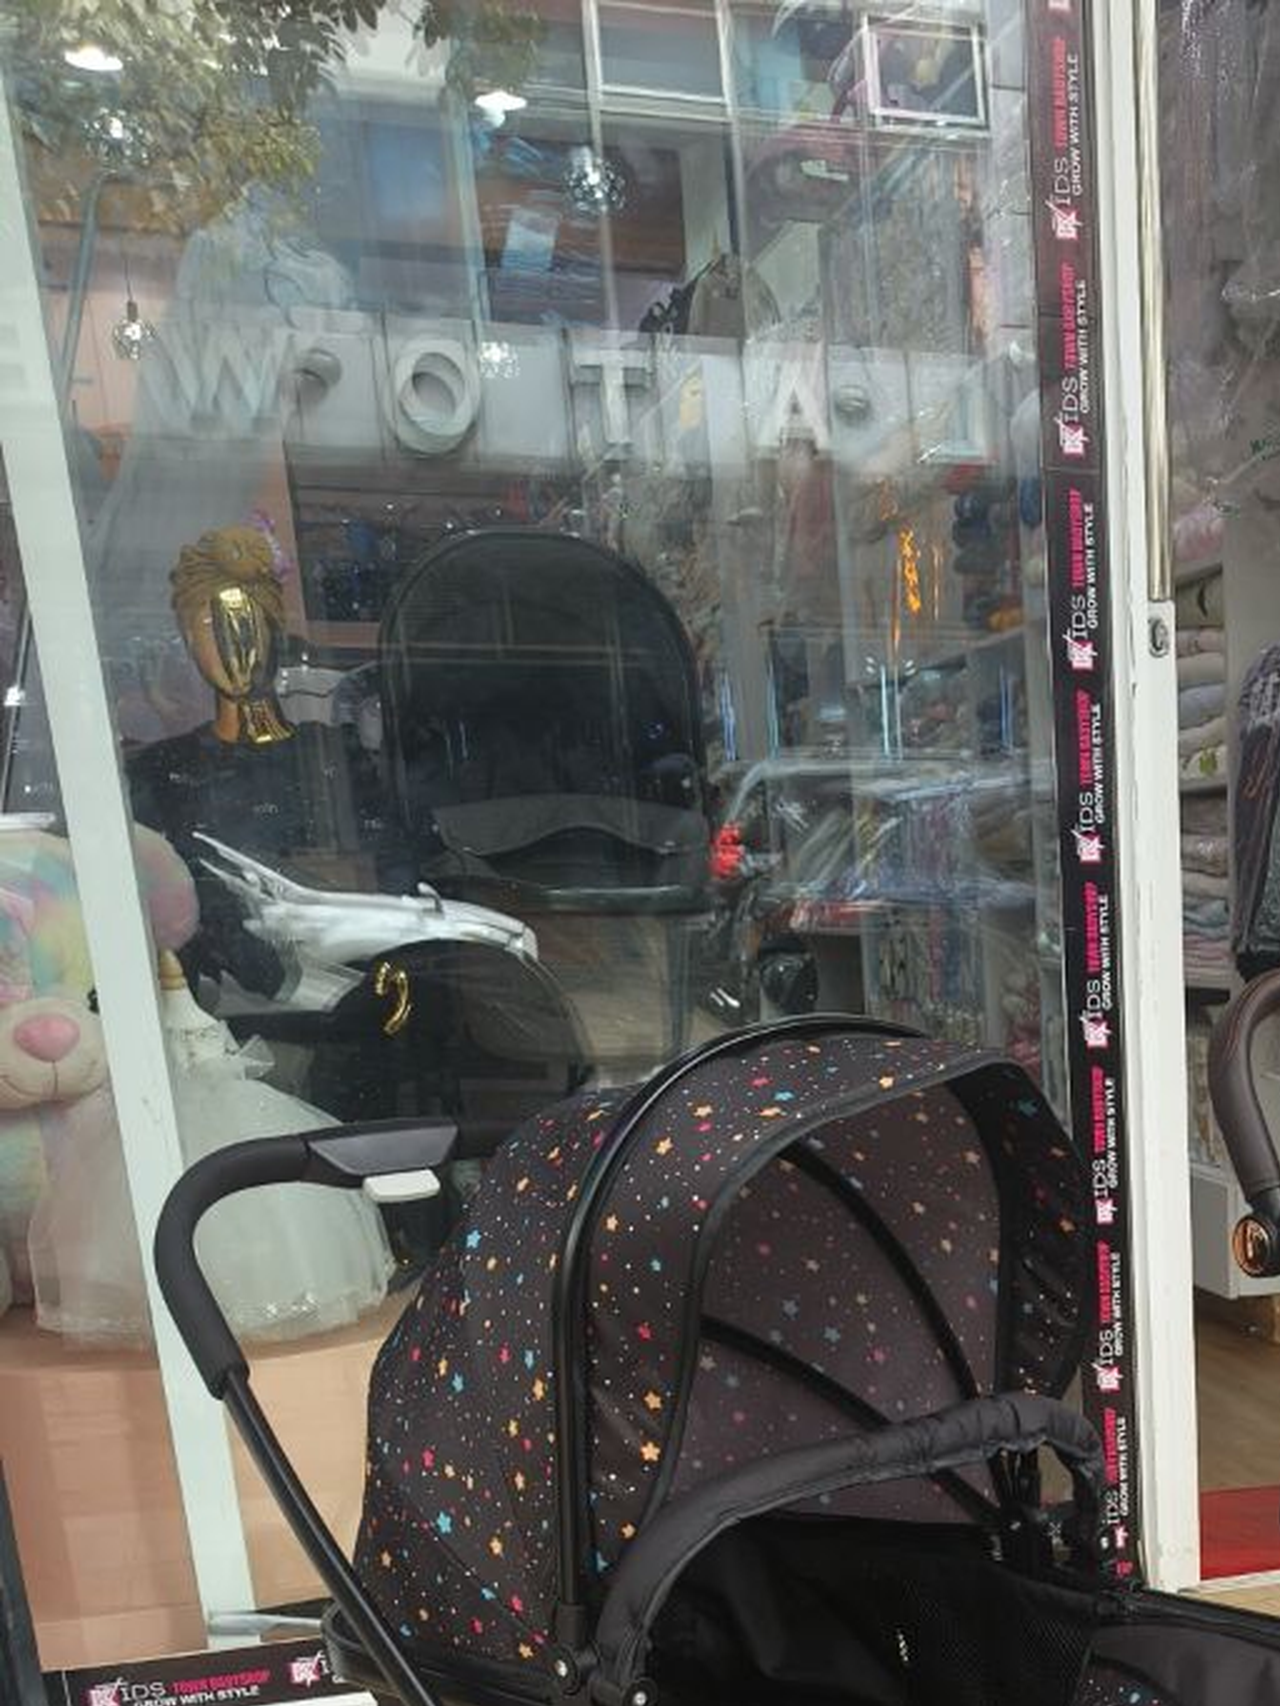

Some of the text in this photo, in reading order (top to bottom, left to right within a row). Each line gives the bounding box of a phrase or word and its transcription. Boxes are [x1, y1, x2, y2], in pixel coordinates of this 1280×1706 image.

[1067, 53, 1083, 195] GROW WITH STYLE
[1076, 280, 1091, 413] GROW WITH STYLE
[1083, 503, 1099, 628] GROW WITH STYLE
[1091, 703, 1106, 823] GROW WITH STYLE
[1099, 895, 1113, 1010] GROW WITH STYLE
[1105, 1077, 1119, 1188] GROW WITH STYLE
[1111, 1252, 1124, 1357] GROW WITH STYLE
[1116, 1416, 1129, 1516] GROW WITH STYLE
[180, 1692, 215, 1706] WITH
[217, 1685, 260, 1700] STYLE
